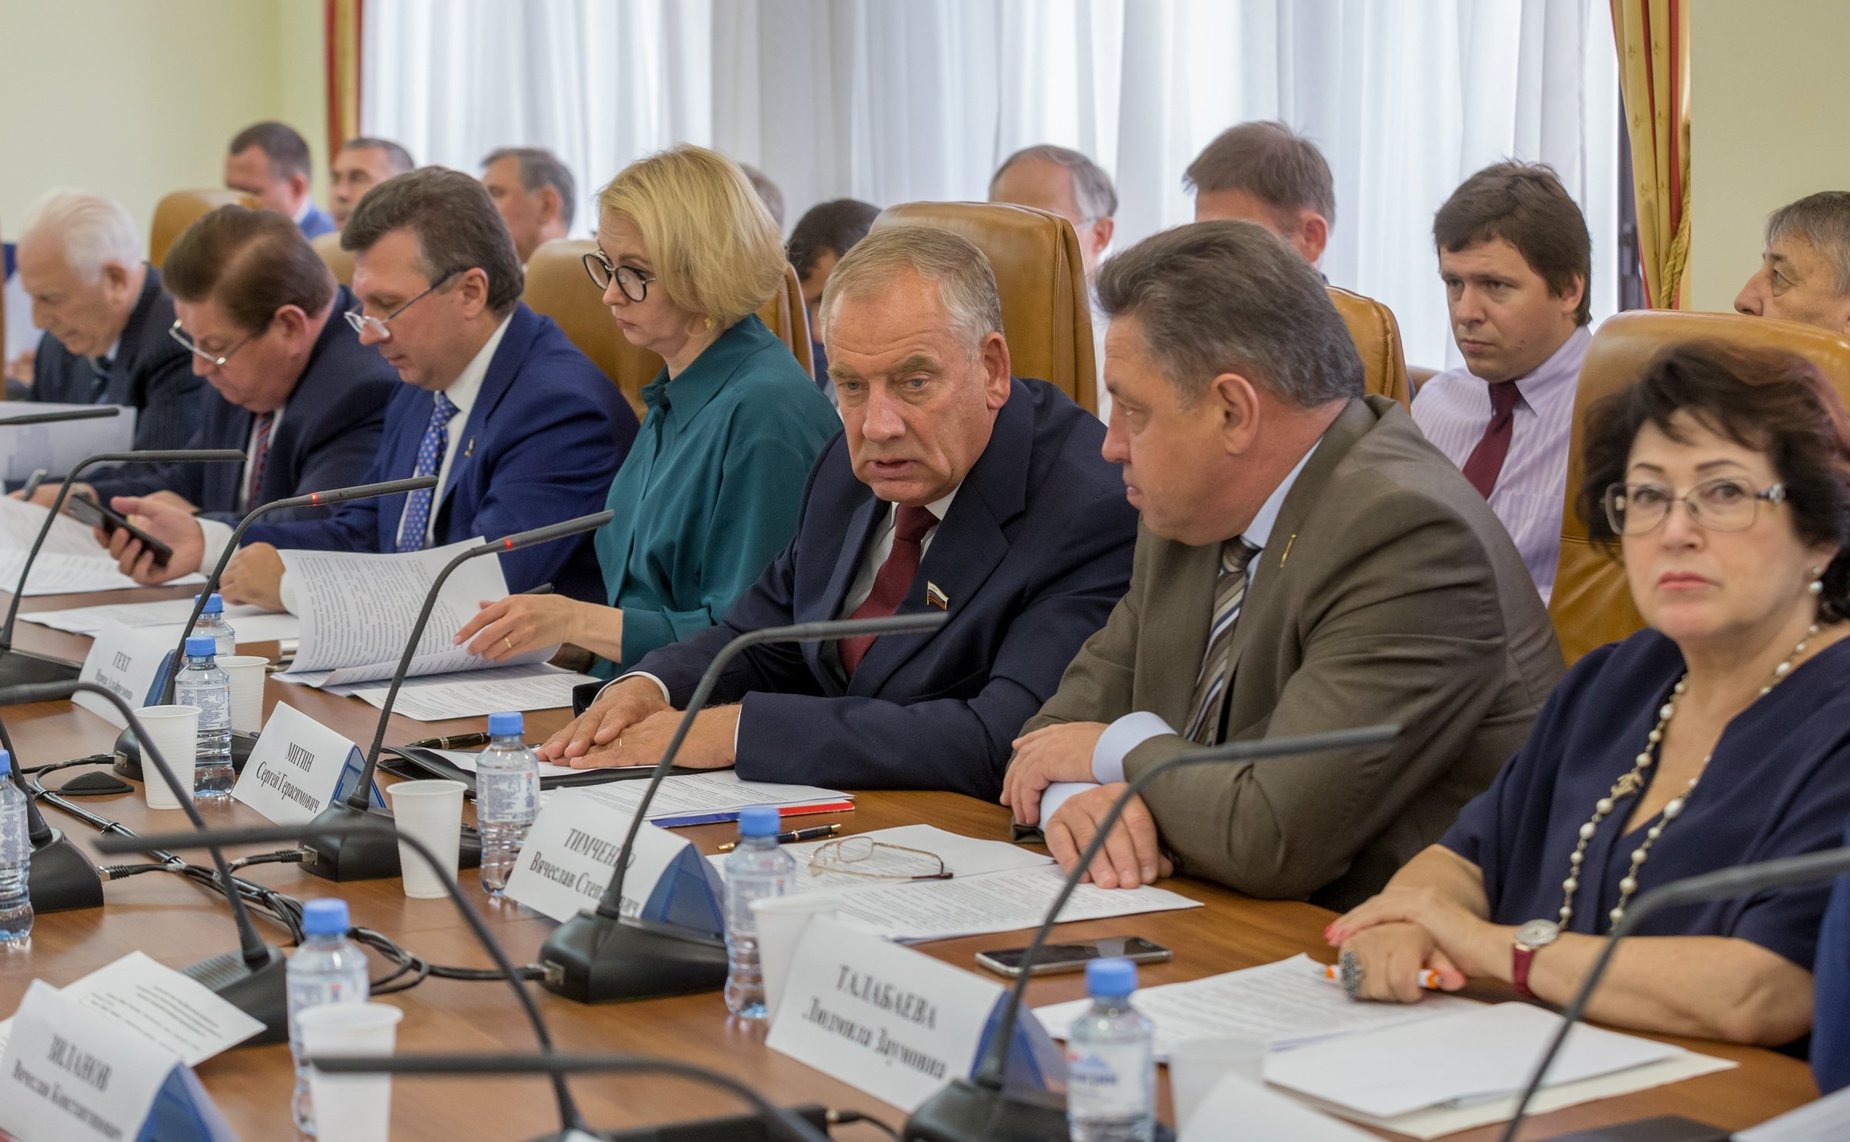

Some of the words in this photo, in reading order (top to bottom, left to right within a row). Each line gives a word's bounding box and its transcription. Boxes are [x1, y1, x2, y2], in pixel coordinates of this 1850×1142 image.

[285, 742, 315, 773] МИТИН
[256, 761, 281, 790] Сергей
[279, 774, 320, 813] Герасимович
[530, 851, 575, 888] Вячеслав
[575, 872, 640, 914] Степвич
[836, 964, 938, 1030] ТАЛАБАЕВА
